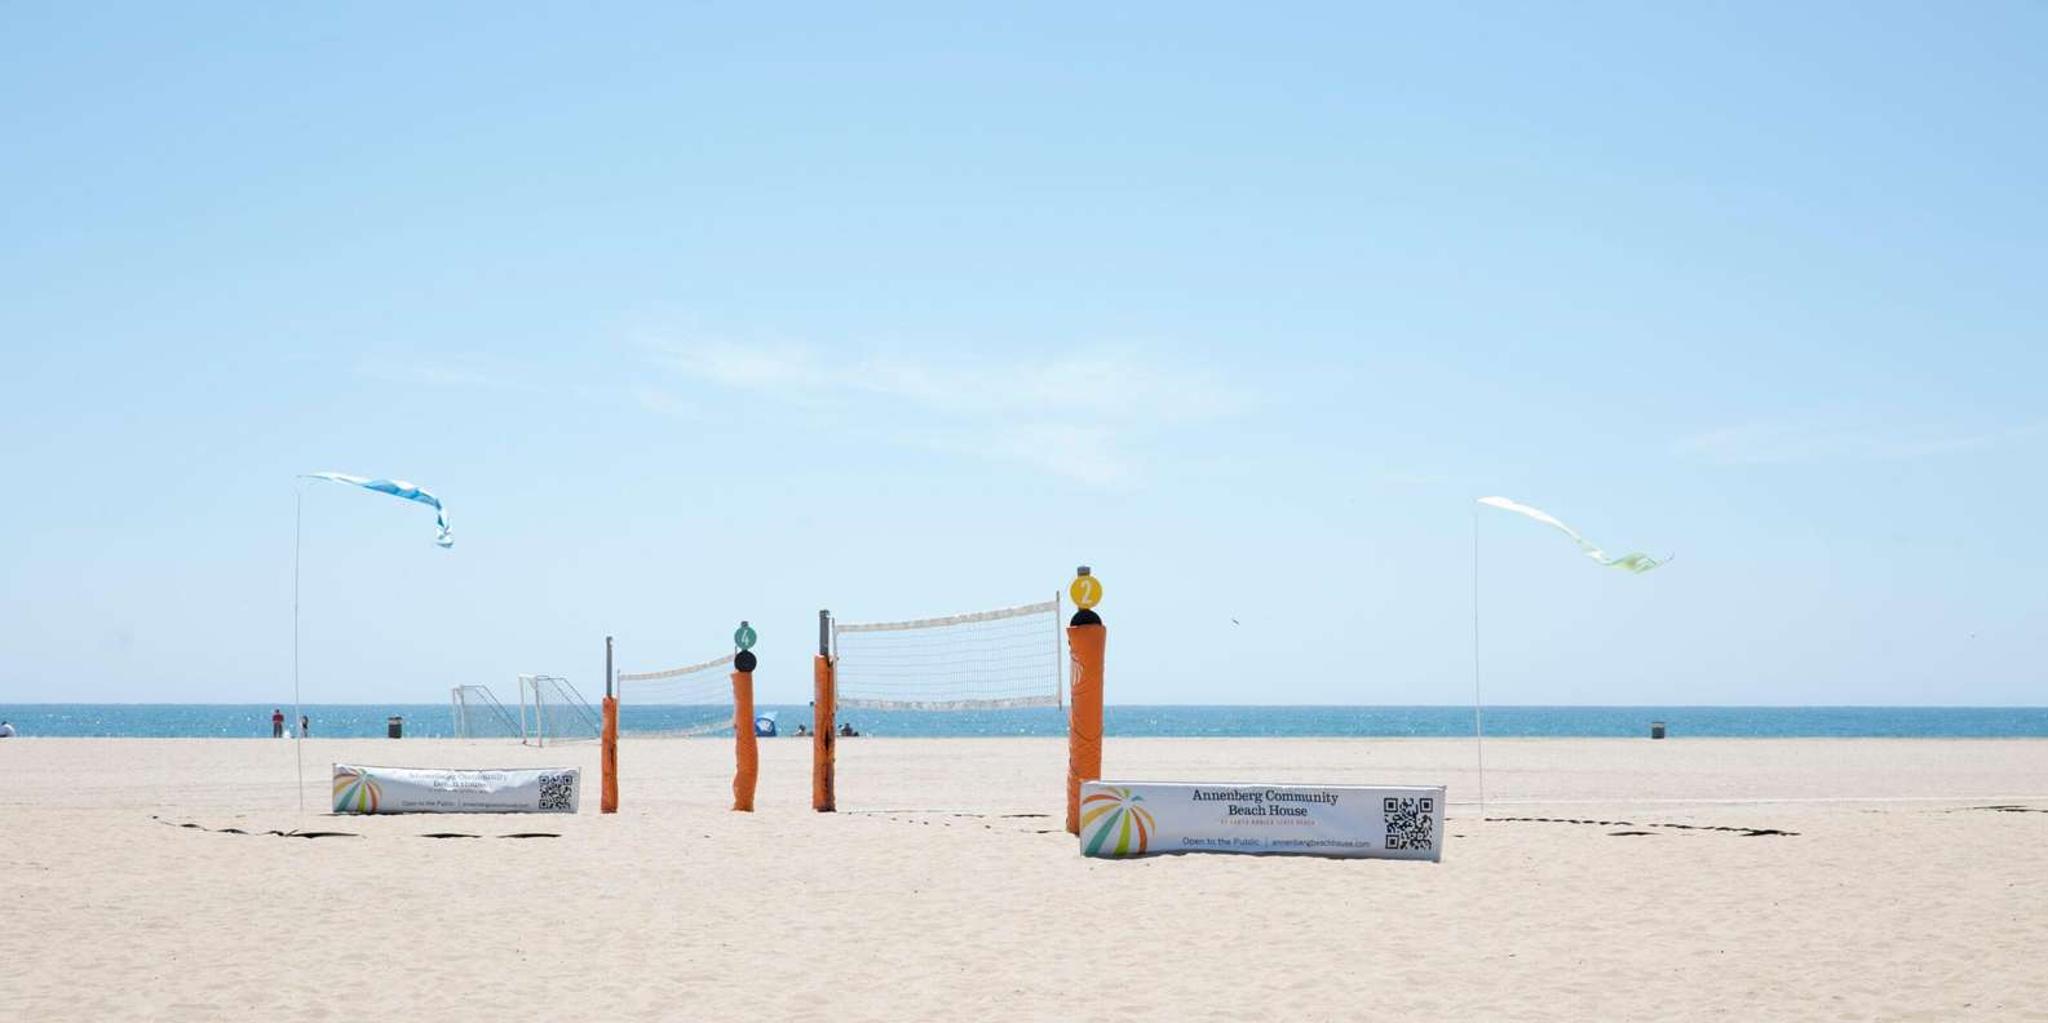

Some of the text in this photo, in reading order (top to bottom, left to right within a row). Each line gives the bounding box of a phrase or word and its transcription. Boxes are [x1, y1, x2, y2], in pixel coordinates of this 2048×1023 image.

[1080, 579, 1092, 604] 2
[741, 629, 750, 646] 4
[1192, 789, 1339, 806] Annenberg Community
[1228, 804, 1308, 817] Beach House
[1182, 836, 1205, 847] Open
[1206, 837, 1217, 847] to
[1217, 837, 1231, 847] the
